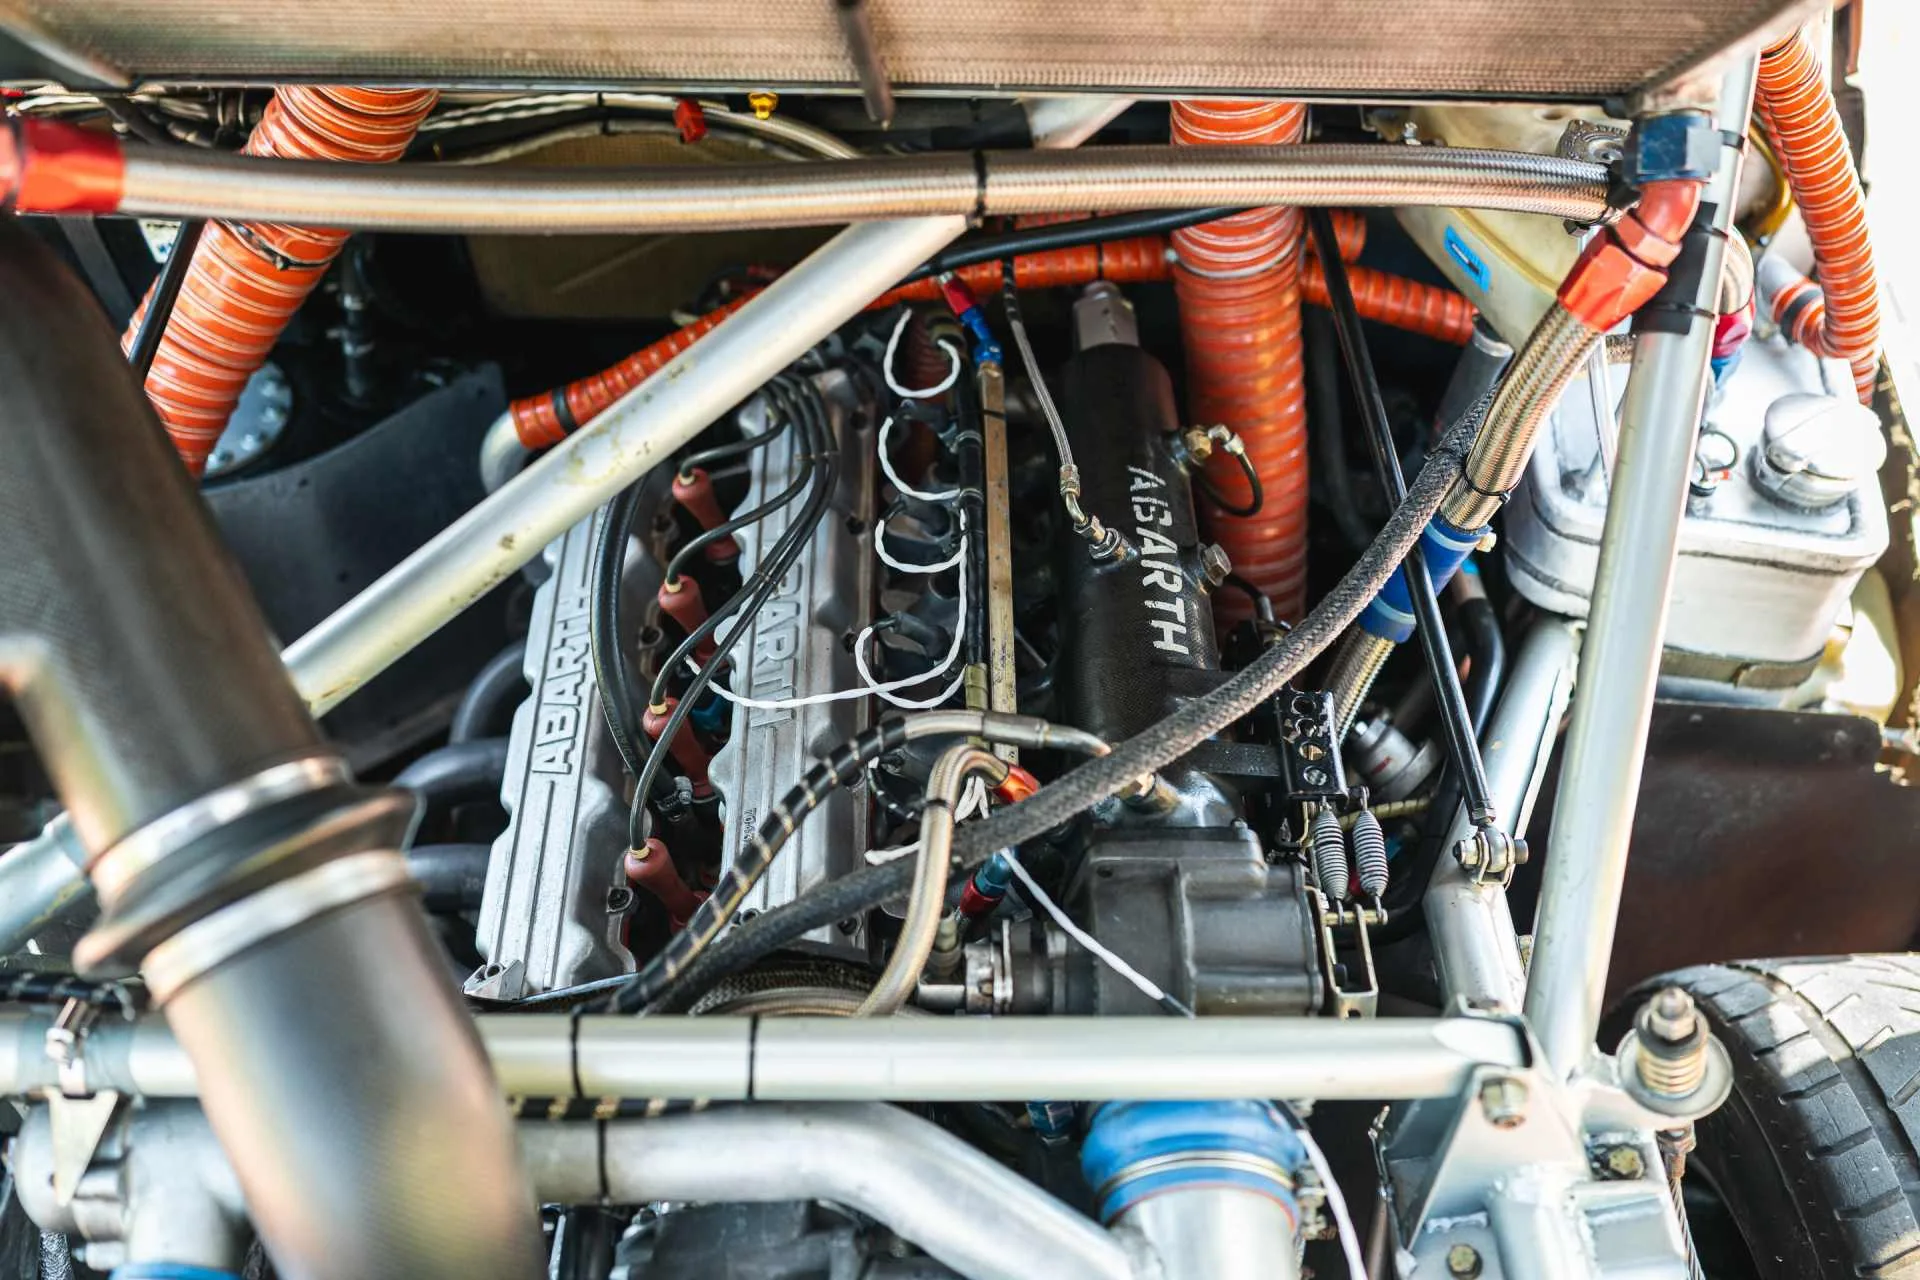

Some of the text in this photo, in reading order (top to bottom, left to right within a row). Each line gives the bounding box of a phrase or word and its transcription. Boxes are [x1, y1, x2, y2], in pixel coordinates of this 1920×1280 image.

[750, 540, 803, 729] BARTH
[1127, 465, 1190, 655] ABARTH
[531, 593, 591, 775] ABARTH
